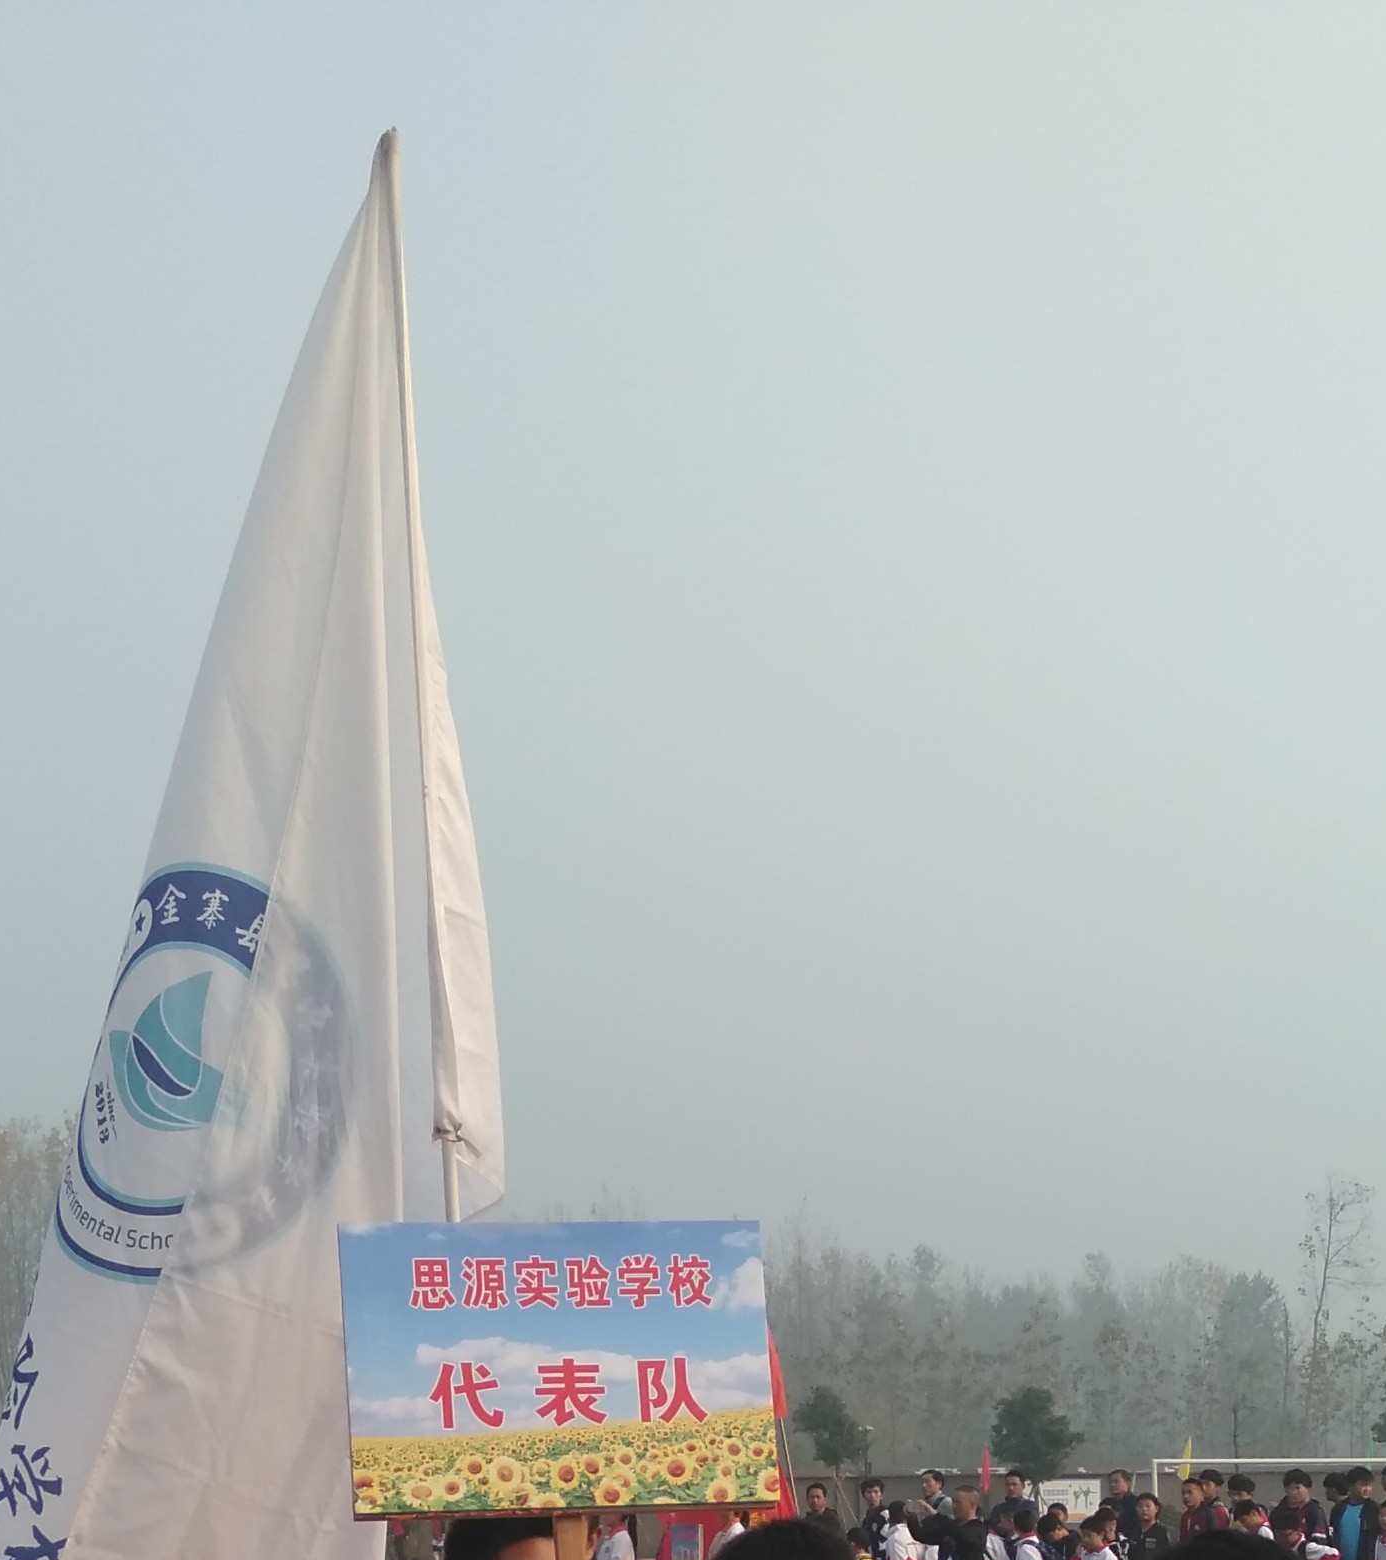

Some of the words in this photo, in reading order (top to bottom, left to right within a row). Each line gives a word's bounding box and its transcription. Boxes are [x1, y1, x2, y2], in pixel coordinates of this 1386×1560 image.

[409, 1253, 714, 1311] 思源实验学校
[429, 1356, 710, 1430] 代表队
